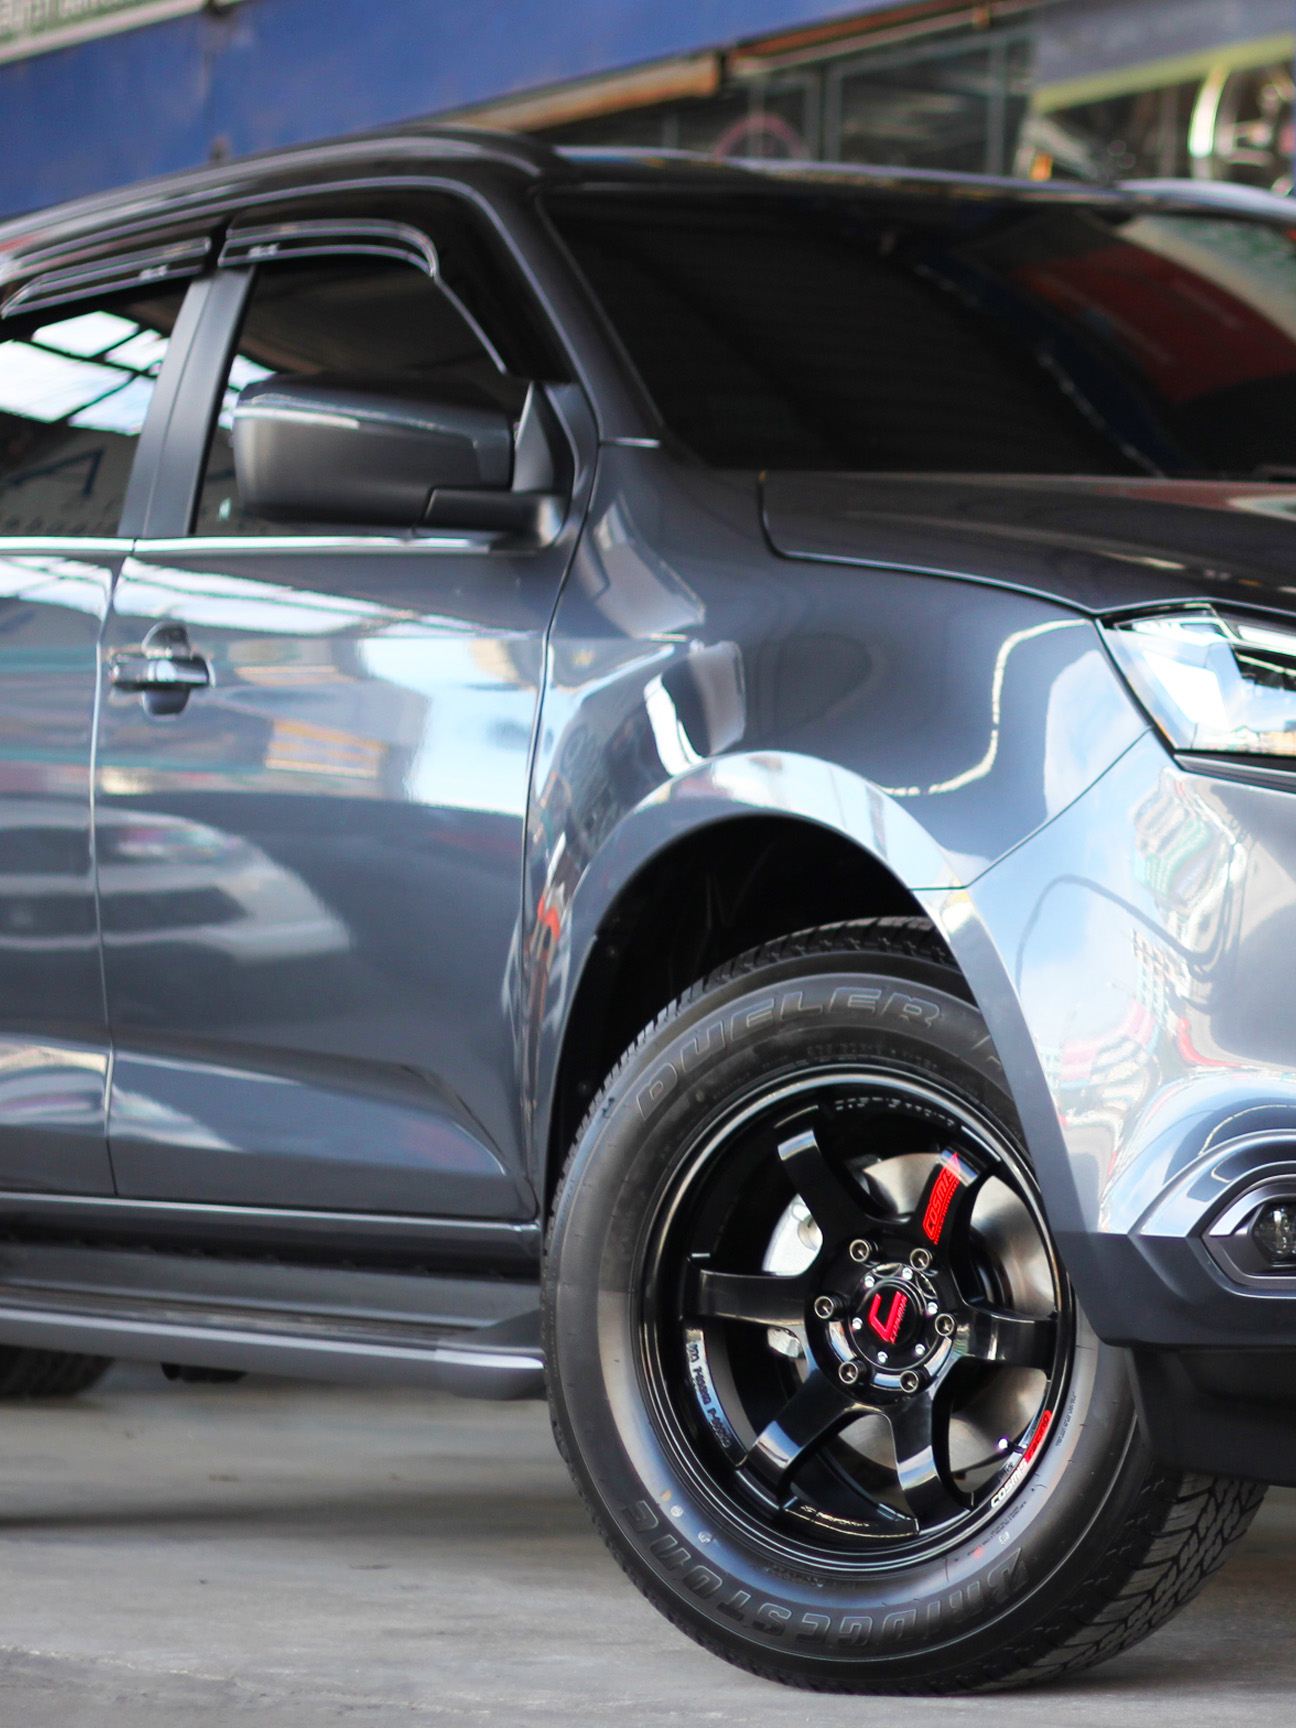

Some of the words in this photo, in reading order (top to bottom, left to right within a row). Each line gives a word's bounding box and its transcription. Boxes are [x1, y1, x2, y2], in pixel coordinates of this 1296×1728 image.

[634, 986, 941, 1121] DUELER
[990, 1457, 1028, 1509] COSMIS
[621, 1500, 1030, 1648] BRIDGESTONE
